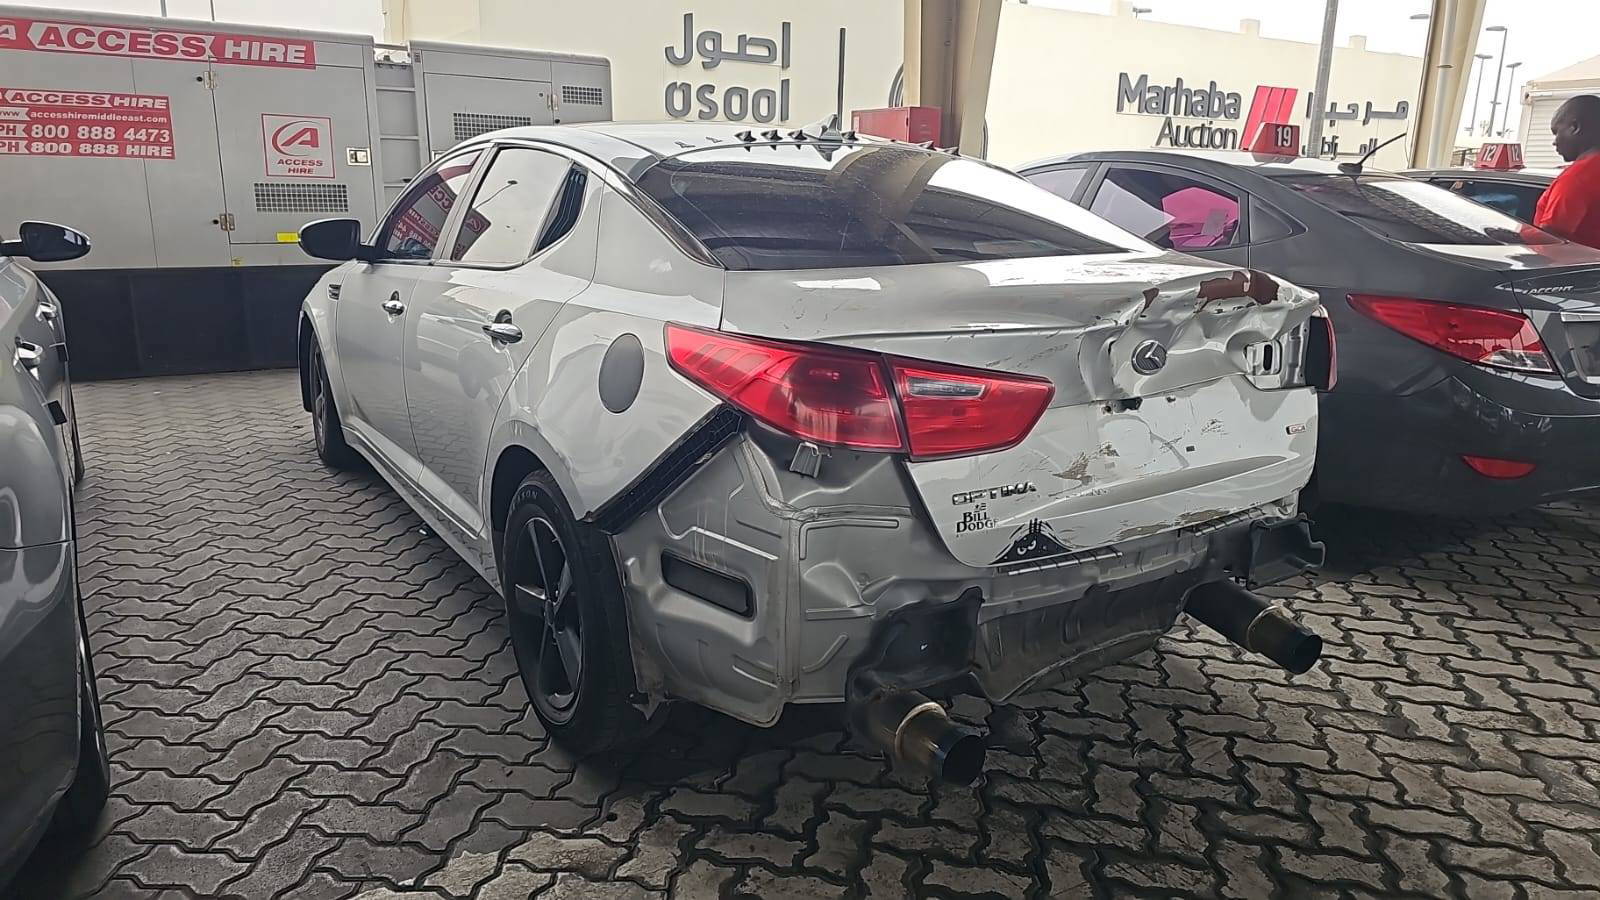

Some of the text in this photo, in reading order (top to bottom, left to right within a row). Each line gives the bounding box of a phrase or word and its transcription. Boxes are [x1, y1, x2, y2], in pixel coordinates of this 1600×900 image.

[37, 26, 209, 58] ACCESS
[224, 40, 307, 63] HIRE
[664, 12, 791, 69] اصول
[11, 92, 168, 108] ACCESS HIRE
[1116, 72, 1242, 120] Marhaba
[30, 111, 167, 123] accesshiremiddleeast.com
[31, 124, 69, 138] 800
[77, 126, 116, 140] 888
[124, 128, 170, 142] 4473
[1155, 117, 1238, 150] Auction
[1276, 126, 1292, 147] 19
[31, 142, 72, 154] 800
[79, 143, 119, 155] 888
[126, 145, 173, 157] HIRE
[1483, 145, 1497, 161] 12
[1511, 145, 1521, 160] 12
[277, 159, 323, 167] ACCESS
[287, 167, 315, 175] HIRE
[1528, 286, 1574, 295] ACCENT
[952, 482, 1037, 505] OPTIMA
[963, 511, 988, 522] BILL
